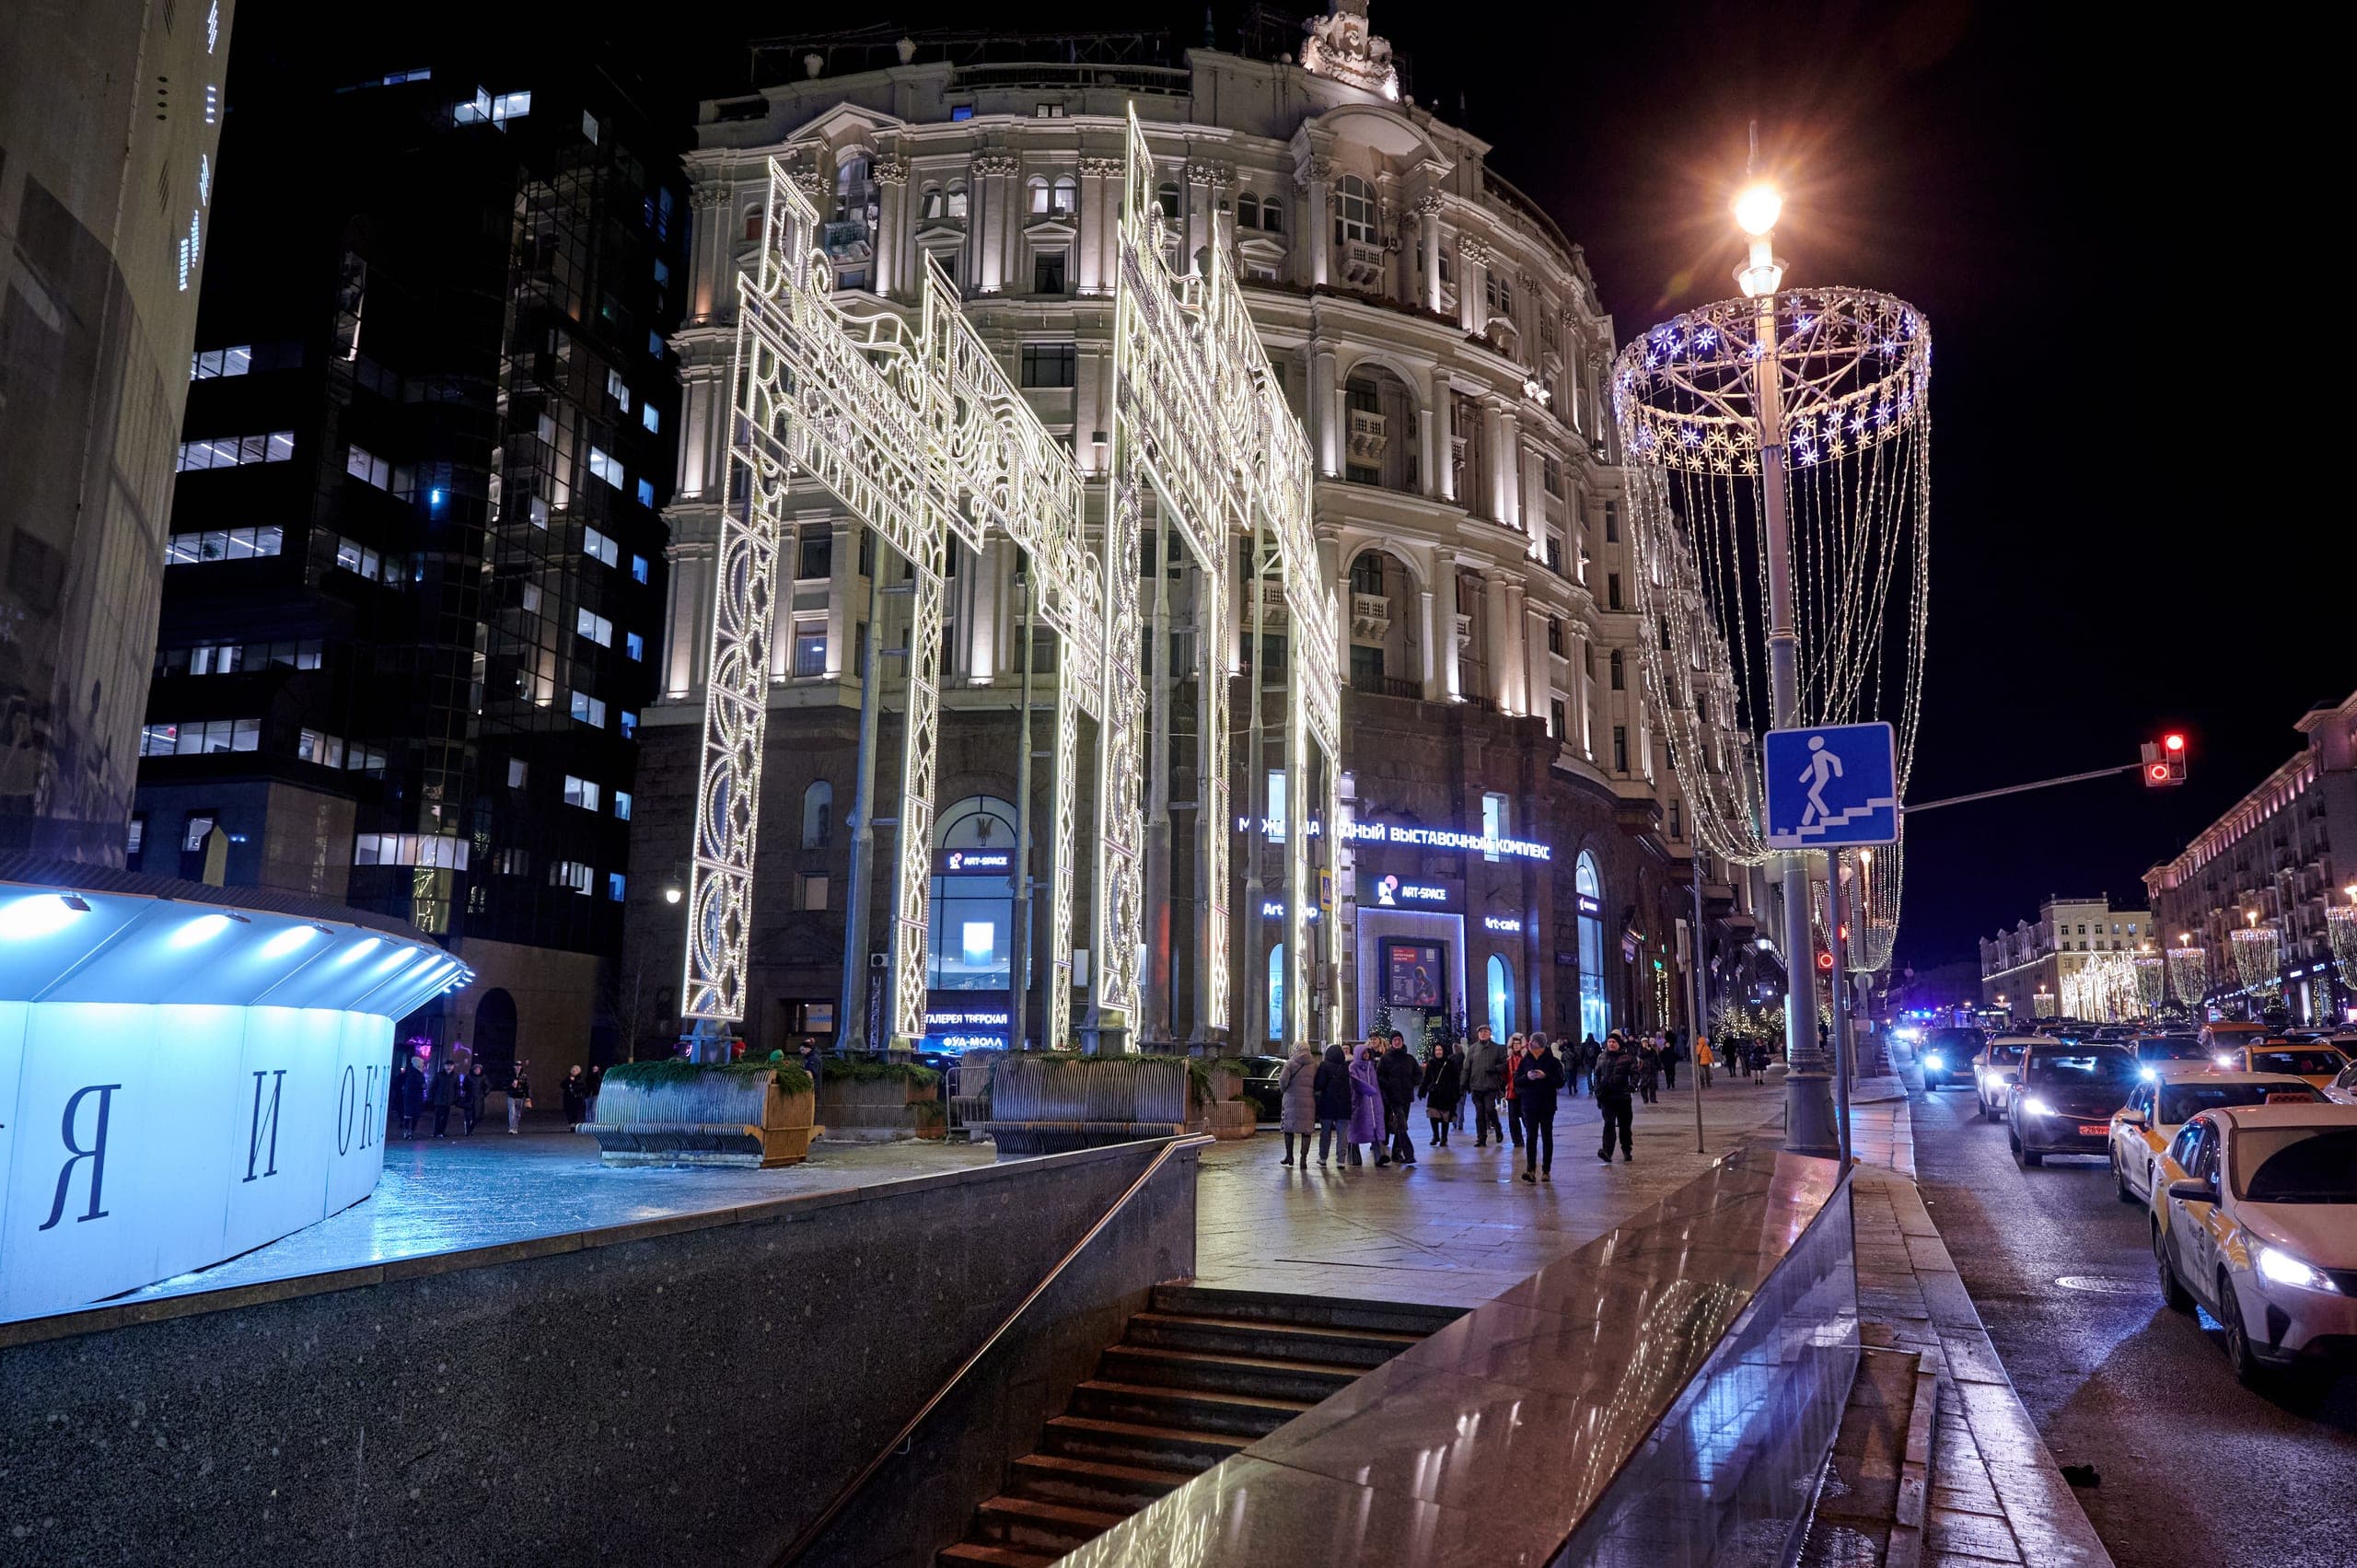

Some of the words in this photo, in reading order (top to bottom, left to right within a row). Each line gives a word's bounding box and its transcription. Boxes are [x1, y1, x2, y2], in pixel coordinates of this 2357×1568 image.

[1390, 827, 1493, 852] ВЫСТАВОЧНЫЙ
[1497, 838, 1550, 860] КОМПЛЕКС
[1402, 886, 1446, 900] ART-SPACE
[925, 1014, 962, 1024] ГАЛЕРЕЯ
[964, 1014, 1007, 1024] ТВЕРСКАЯ
[243, 1070, 286, 1183] И
